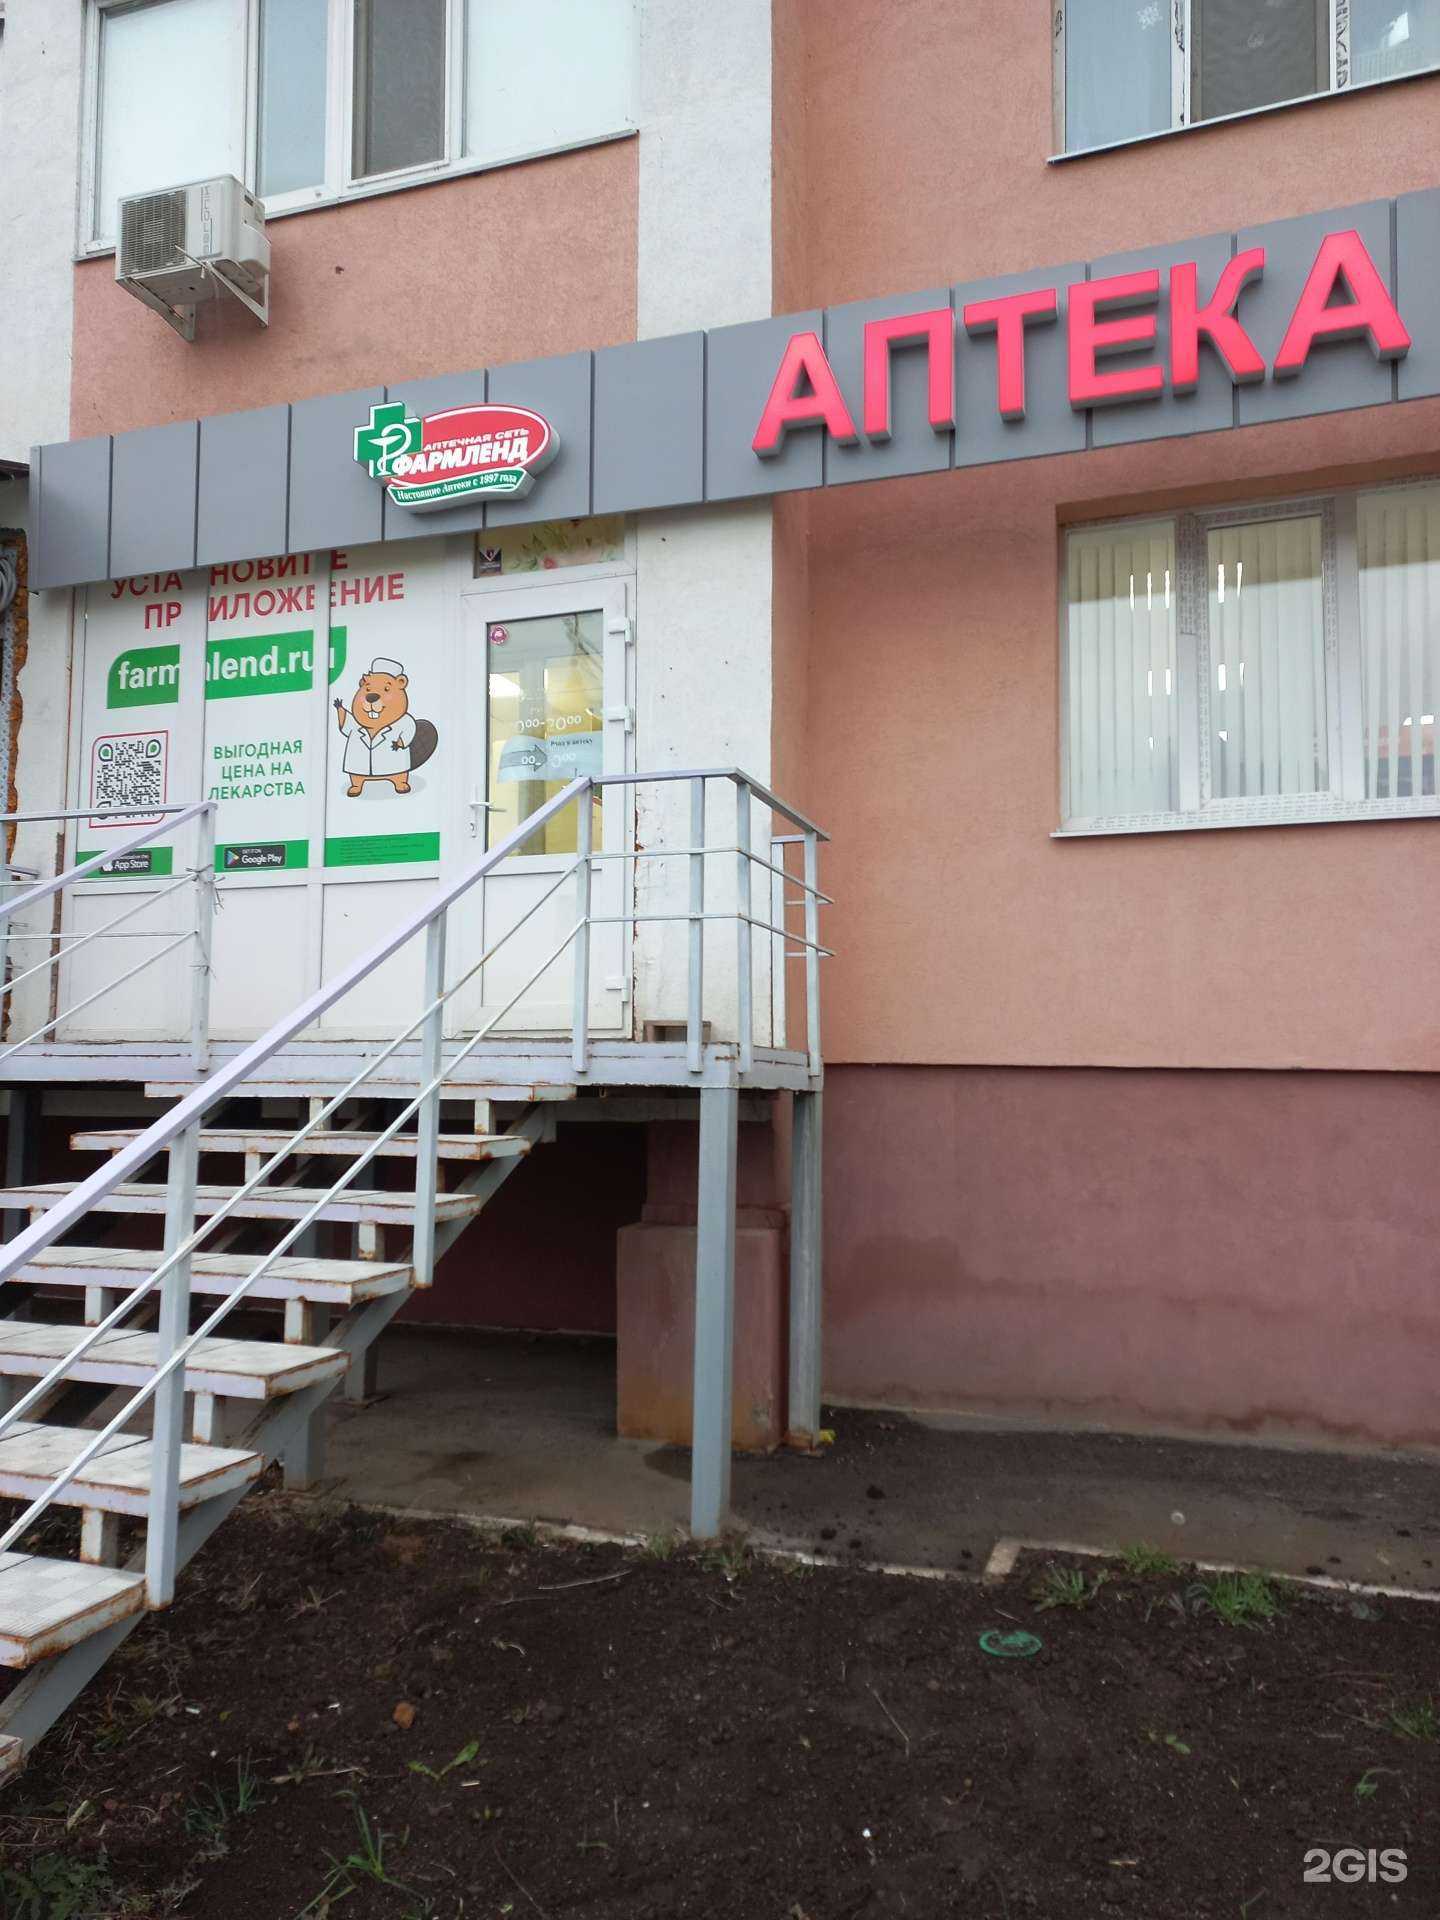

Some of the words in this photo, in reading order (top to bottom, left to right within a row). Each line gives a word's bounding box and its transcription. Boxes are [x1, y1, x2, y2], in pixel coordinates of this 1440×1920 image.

[752, 229, 1411, 460] АПТЕКА
[423, 433, 491, 452] АПТЕЧНАЯ
[494, 428, 530, 440] СЕТЬ
[391, 437, 528, 476] ФАРМЛЕНД
[213, 739, 303, 760] ВЫГОДНАЯ
[222, 763, 266, 782] ЦЕНА
[271, 761, 294, 776] НА
[208, 781, 305, 801] ЛЕКАРСТВА
[114, 860, 130, 871] App
[130, 859, 149, 869] Store
[241, 854, 267, 866] Google
[267, 853, 282, 864] Play
